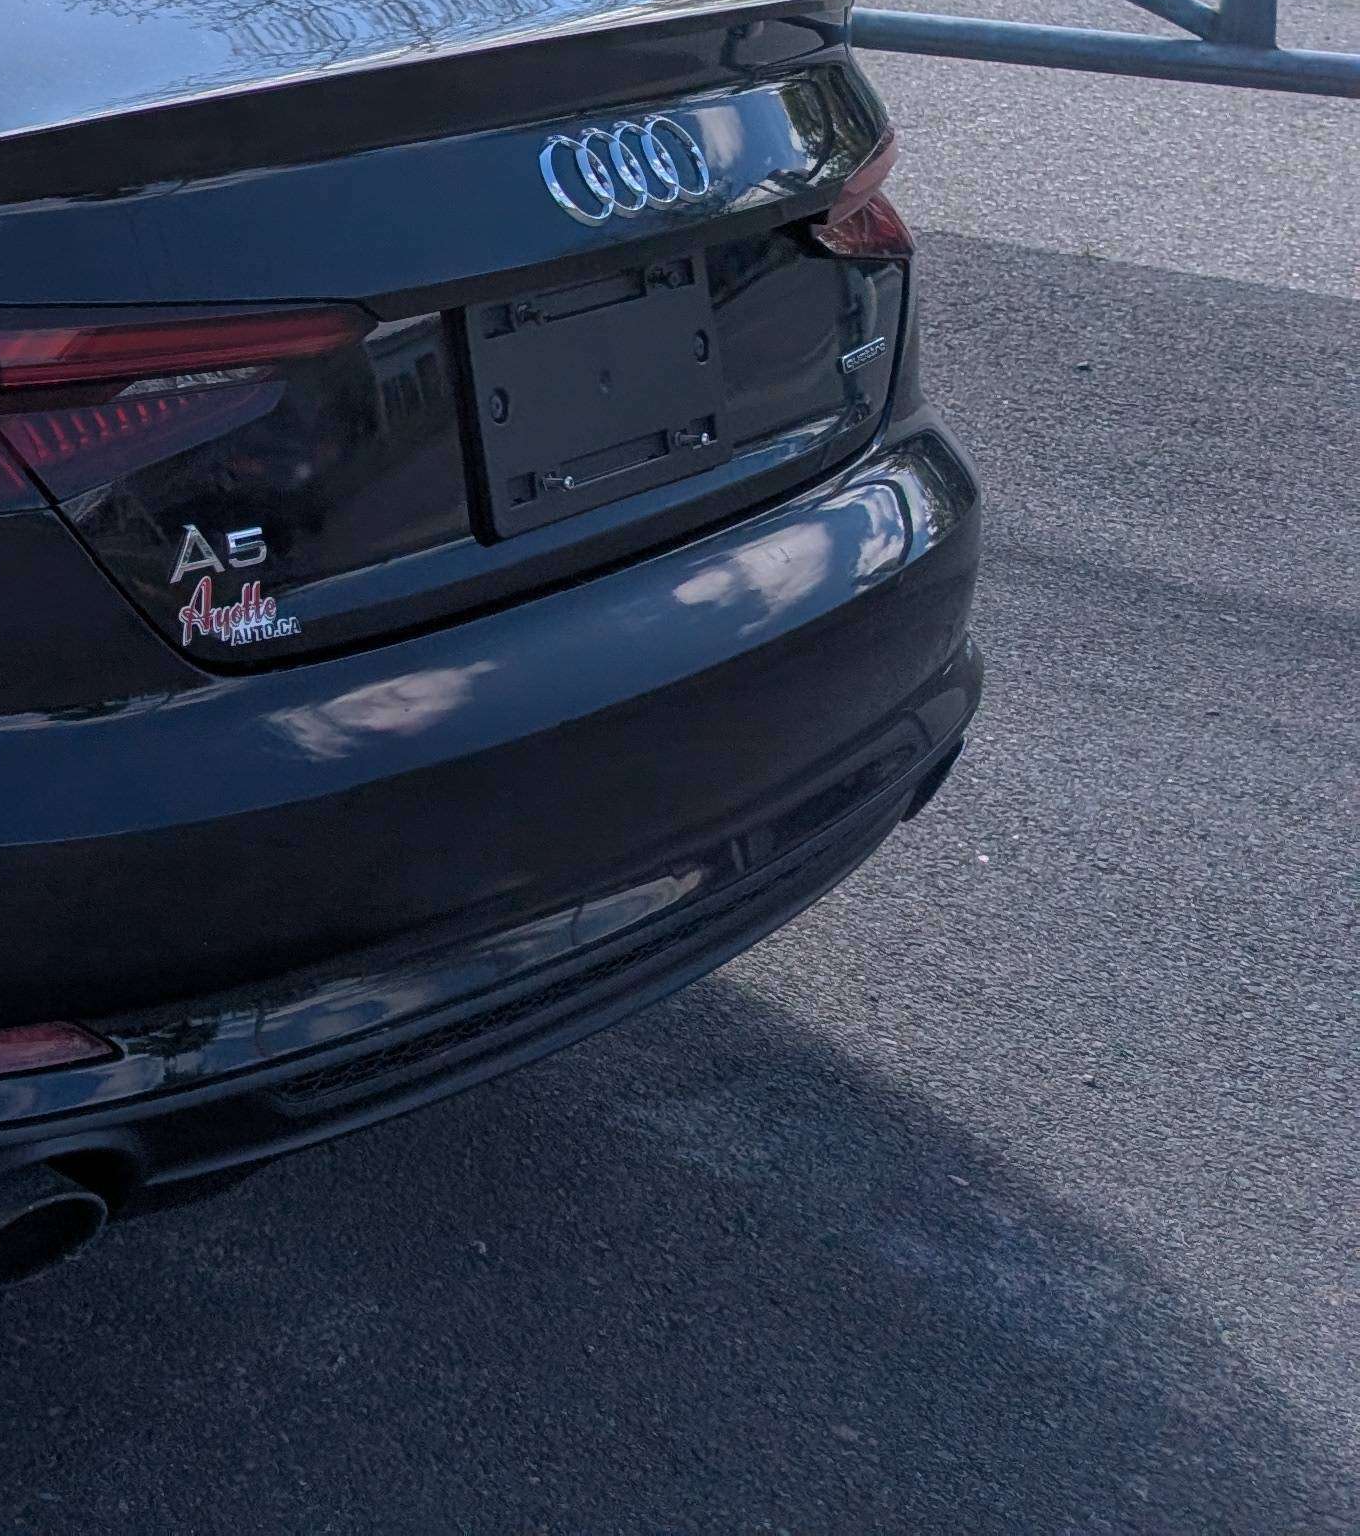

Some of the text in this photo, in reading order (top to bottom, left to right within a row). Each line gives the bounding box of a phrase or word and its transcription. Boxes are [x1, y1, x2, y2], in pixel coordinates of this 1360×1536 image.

[169, 524, 268, 584] A5
[178, 575, 277, 647] Ayotte
[230, 616, 302, 647] AUTO.CA
